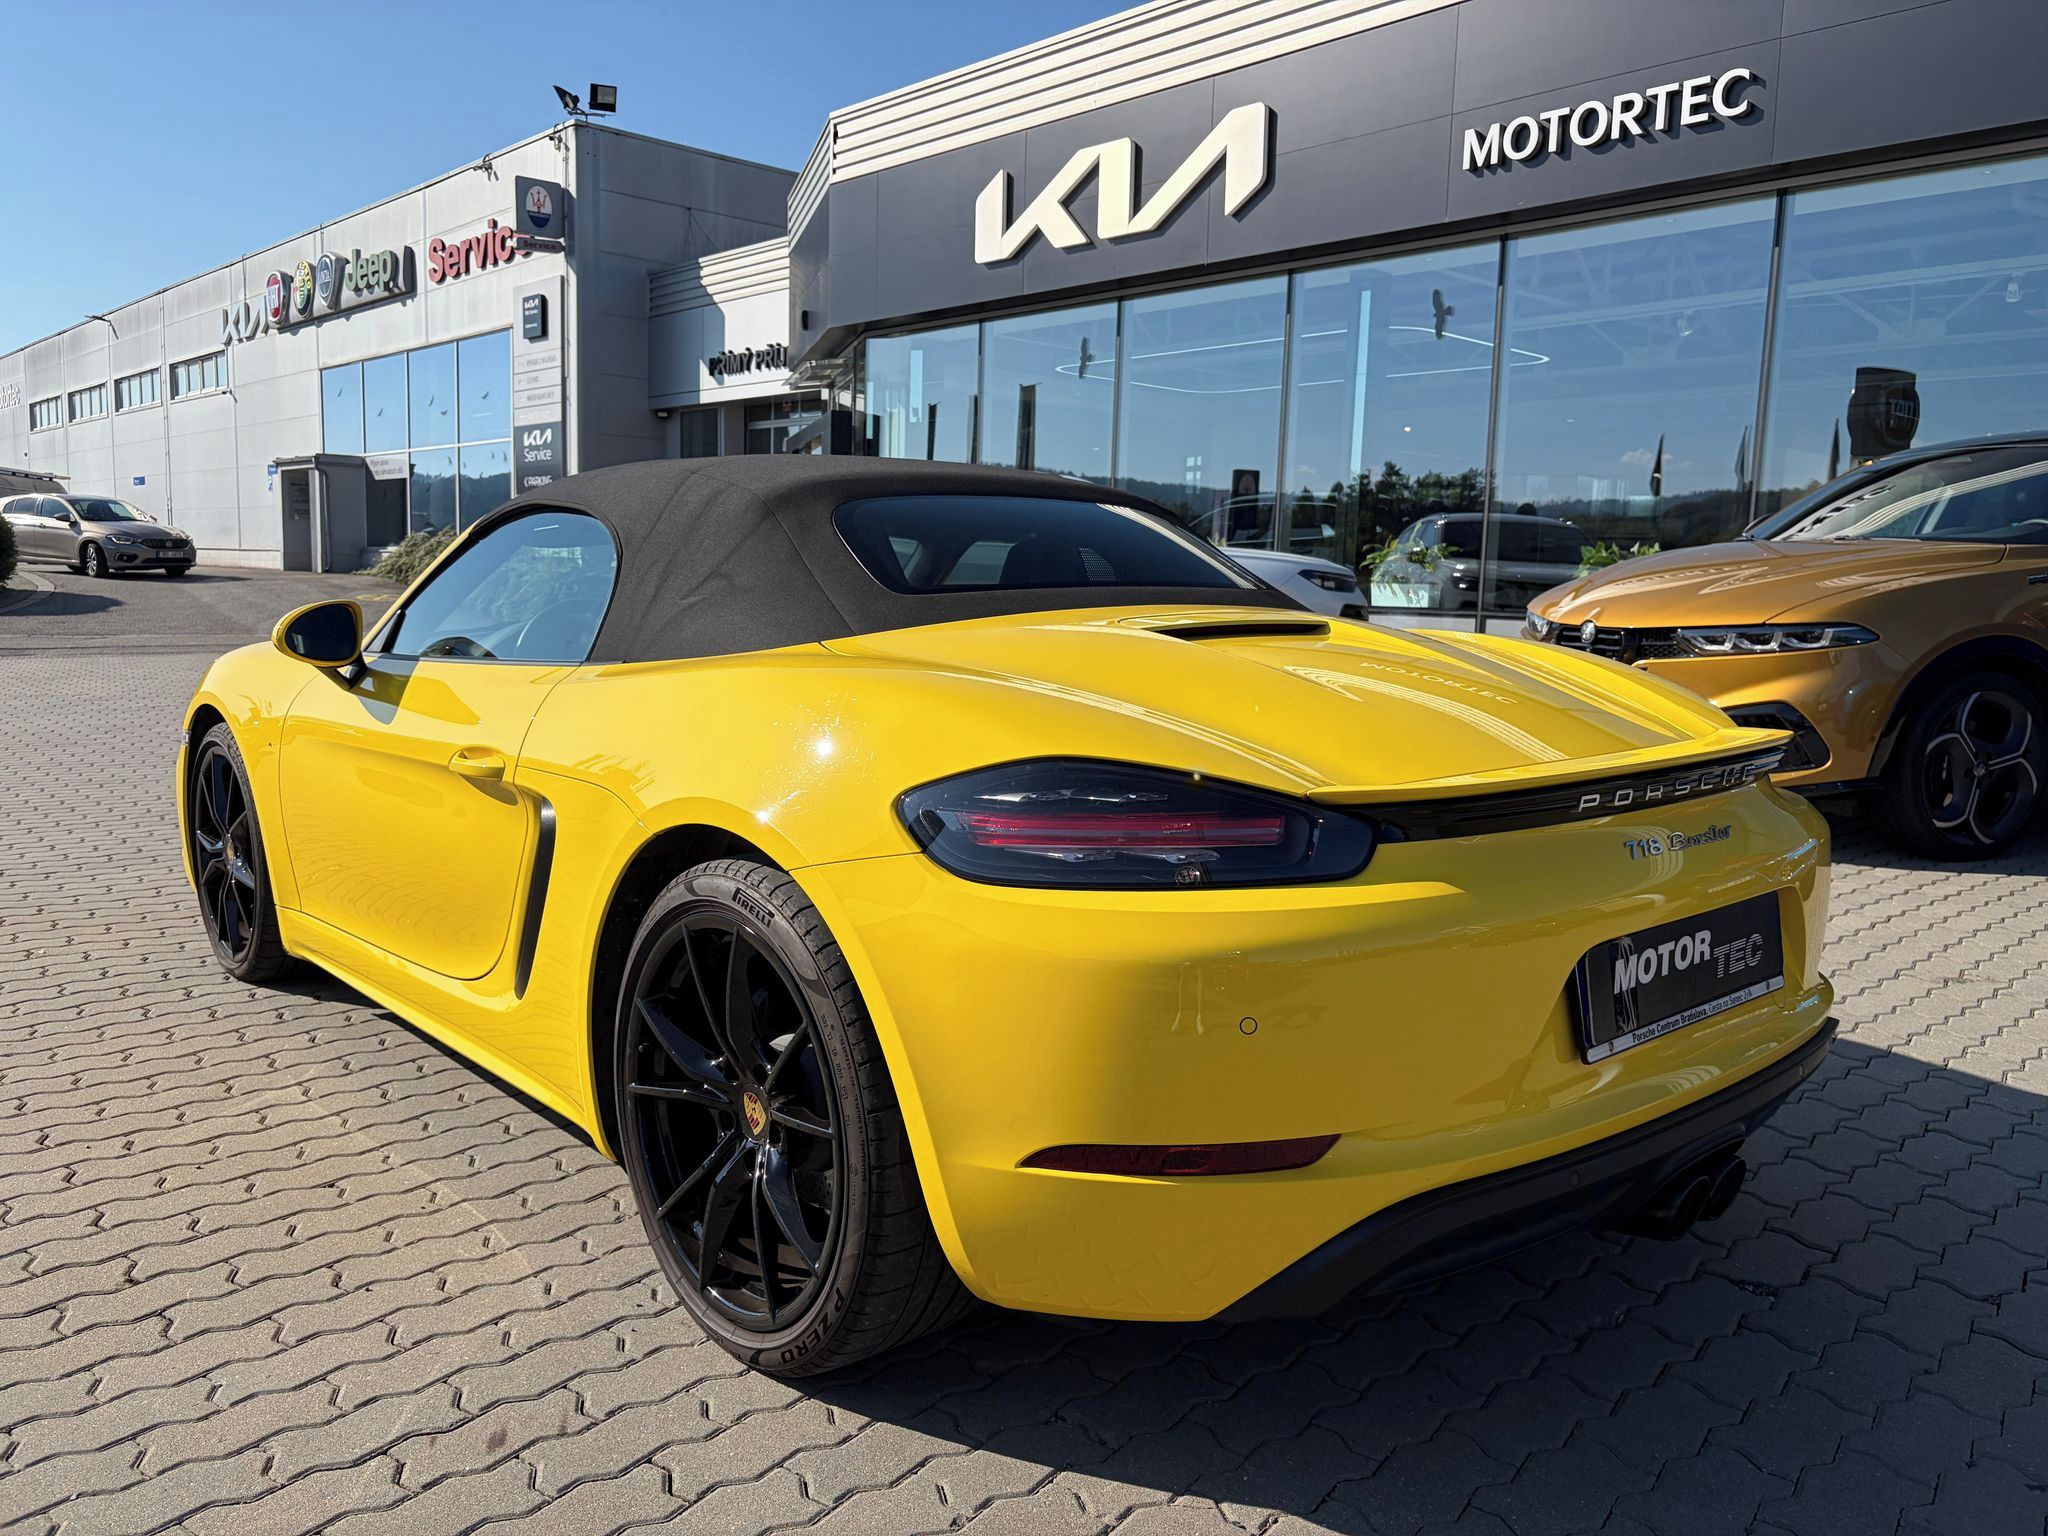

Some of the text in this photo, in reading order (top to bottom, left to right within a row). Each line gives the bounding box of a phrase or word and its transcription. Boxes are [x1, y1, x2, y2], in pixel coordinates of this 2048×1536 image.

[1462, 68, 1752, 171] MOTORTEC
[975, 102, 1267, 264] KIA
[345, 249, 392, 292] Jeep
[429, 218, 530, 283] Servic
[523, 428, 552, 446] KIA
[523, 447, 552, 462] Service
[1577, 765, 1756, 812] PORSCHE
[1623, 838, 1663, 861] 718
[732, 887, 775, 928] PIRELLI
[1613, 929, 1763, 995] MOTOR TEC
[1632, 1027, 1656, 1043] Porsche
[1656, 1018, 1680, 1034] Centrum
[1680, 1007, 1708, 1025] Bratislava,
[1708, 1001, 1723, 1013] Cesta
[1729, 993, 1744, 1006] Senec
[780, 1286, 845, 1364] P ZERO
